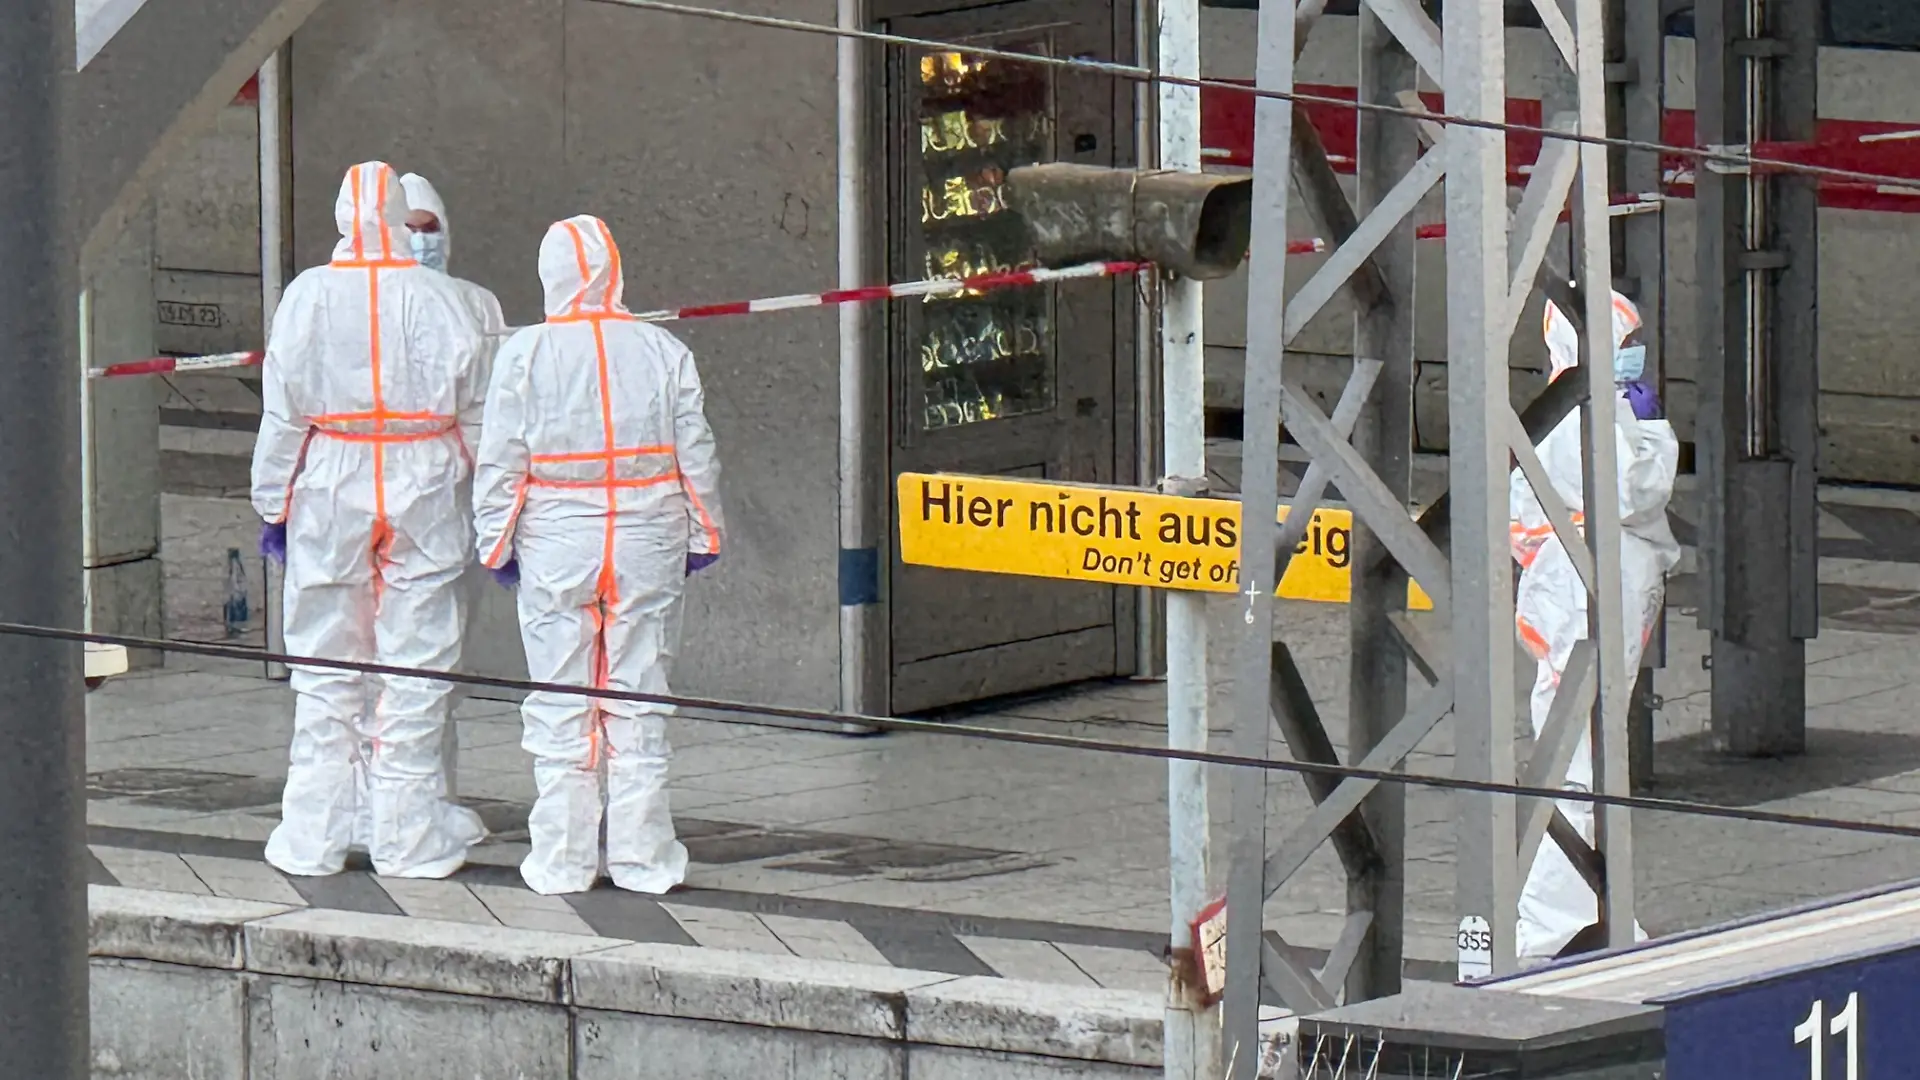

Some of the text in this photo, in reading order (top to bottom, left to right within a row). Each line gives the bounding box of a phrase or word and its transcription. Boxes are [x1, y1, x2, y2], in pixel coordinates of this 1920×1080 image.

[922, 481, 1013, 528] Hier
[1030, 492, 1141, 541] nicht
[1082, 547, 1152, 577] Don't
[1159, 557, 1202, 583] get
[1457, 930, 1490, 951] 355
[1793, 991, 1858, 1080] 11
